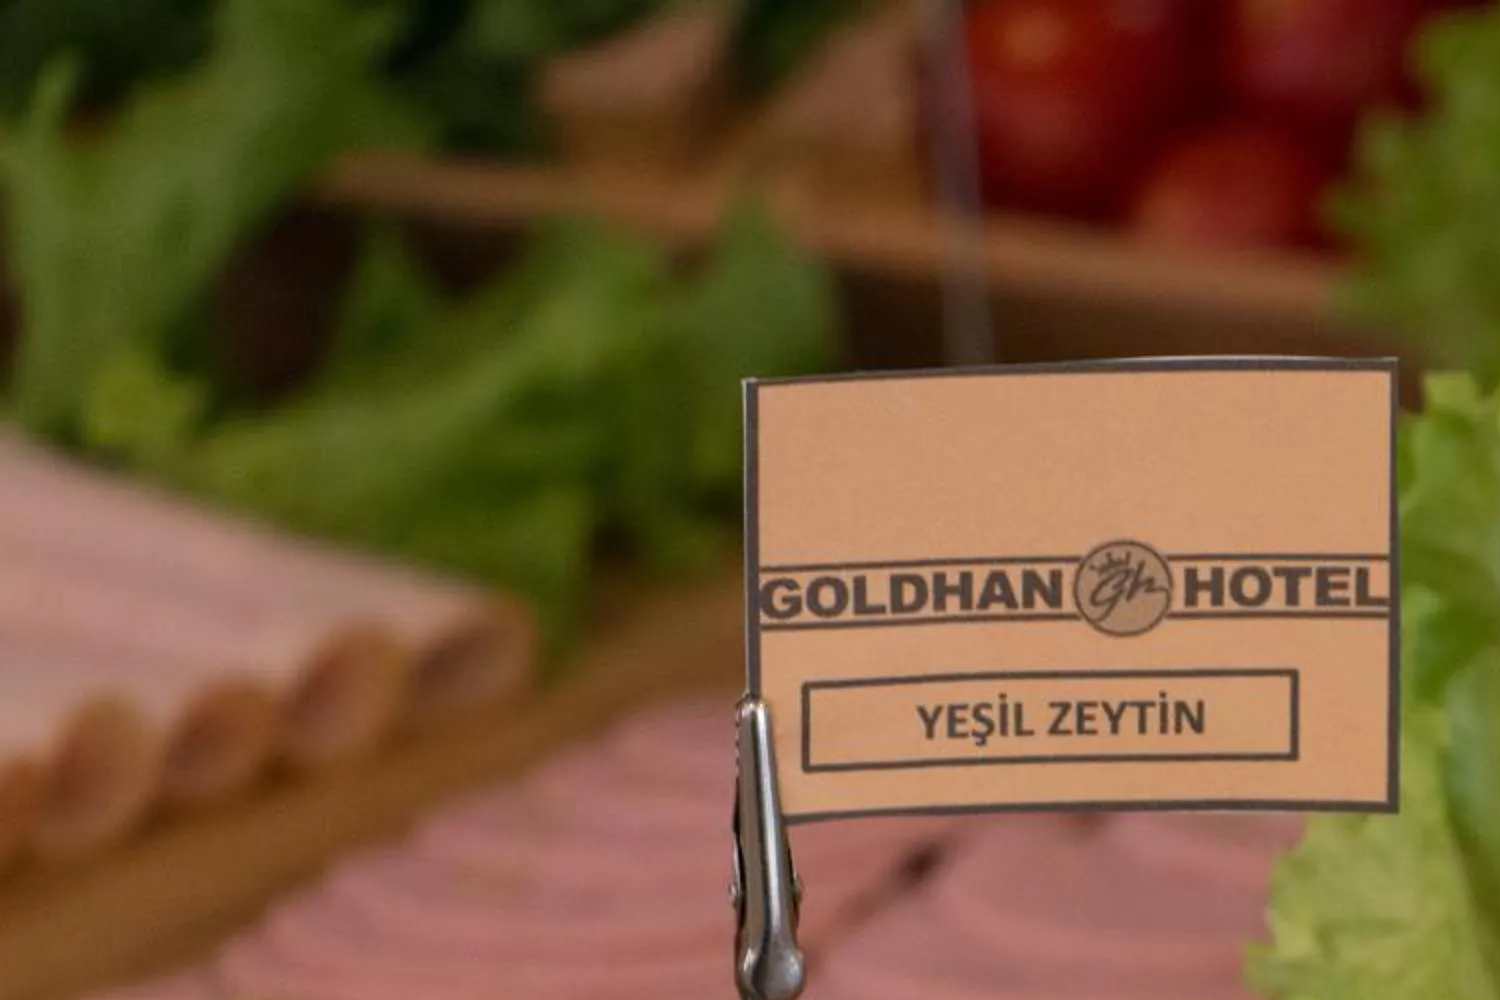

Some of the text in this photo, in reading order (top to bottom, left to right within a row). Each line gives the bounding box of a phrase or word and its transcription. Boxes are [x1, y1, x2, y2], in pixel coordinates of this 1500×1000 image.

[761, 568, 1063, 620] GOLDHAN
[1184, 565, 1389, 608] HOTEL
[916, 691, 1206, 746] YEŞİL ZEYTİN
